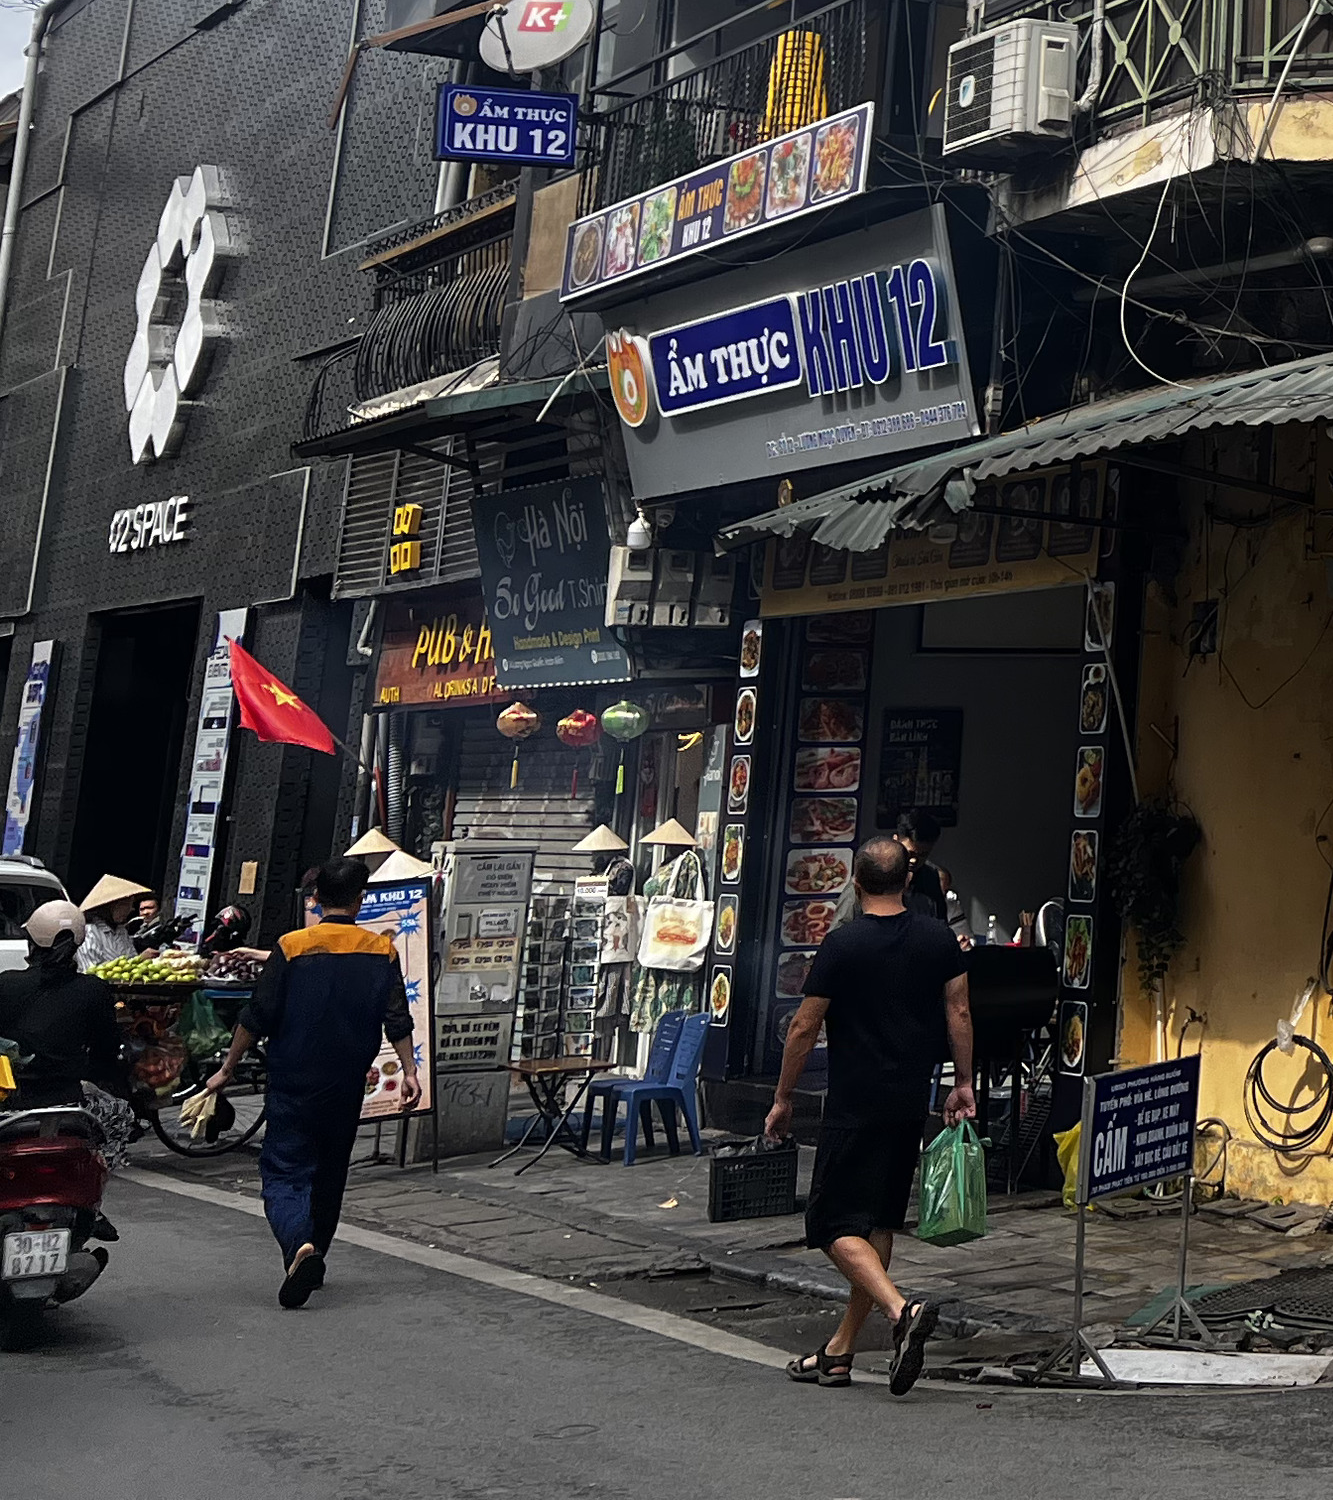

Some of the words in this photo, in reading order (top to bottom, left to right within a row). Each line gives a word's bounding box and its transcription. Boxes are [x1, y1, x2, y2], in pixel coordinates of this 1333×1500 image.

[525, 6, 567, 28] K+
[478, 98, 510, 119] ẨM
[513, 105, 568, 125] THỰC
[453, 122, 518, 152] KHU
[529, 128, 567, 156] 12
[681, 219, 701, 248] KHU
[701, 215, 712, 241] 12
[668, 338, 708, 398] ẨM
[710, 327, 791, 385] THỰC
[798, 271, 891, 399] KHU
[886, 258, 949, 374] 12
[411, 613, 458, 669] PUB
[458, 622, 474, 663] &
[380, 889, 406, 903] KHU
[408, 888, 423, 901] 12
[1093, 1112, 1129, 1178] CẤM
